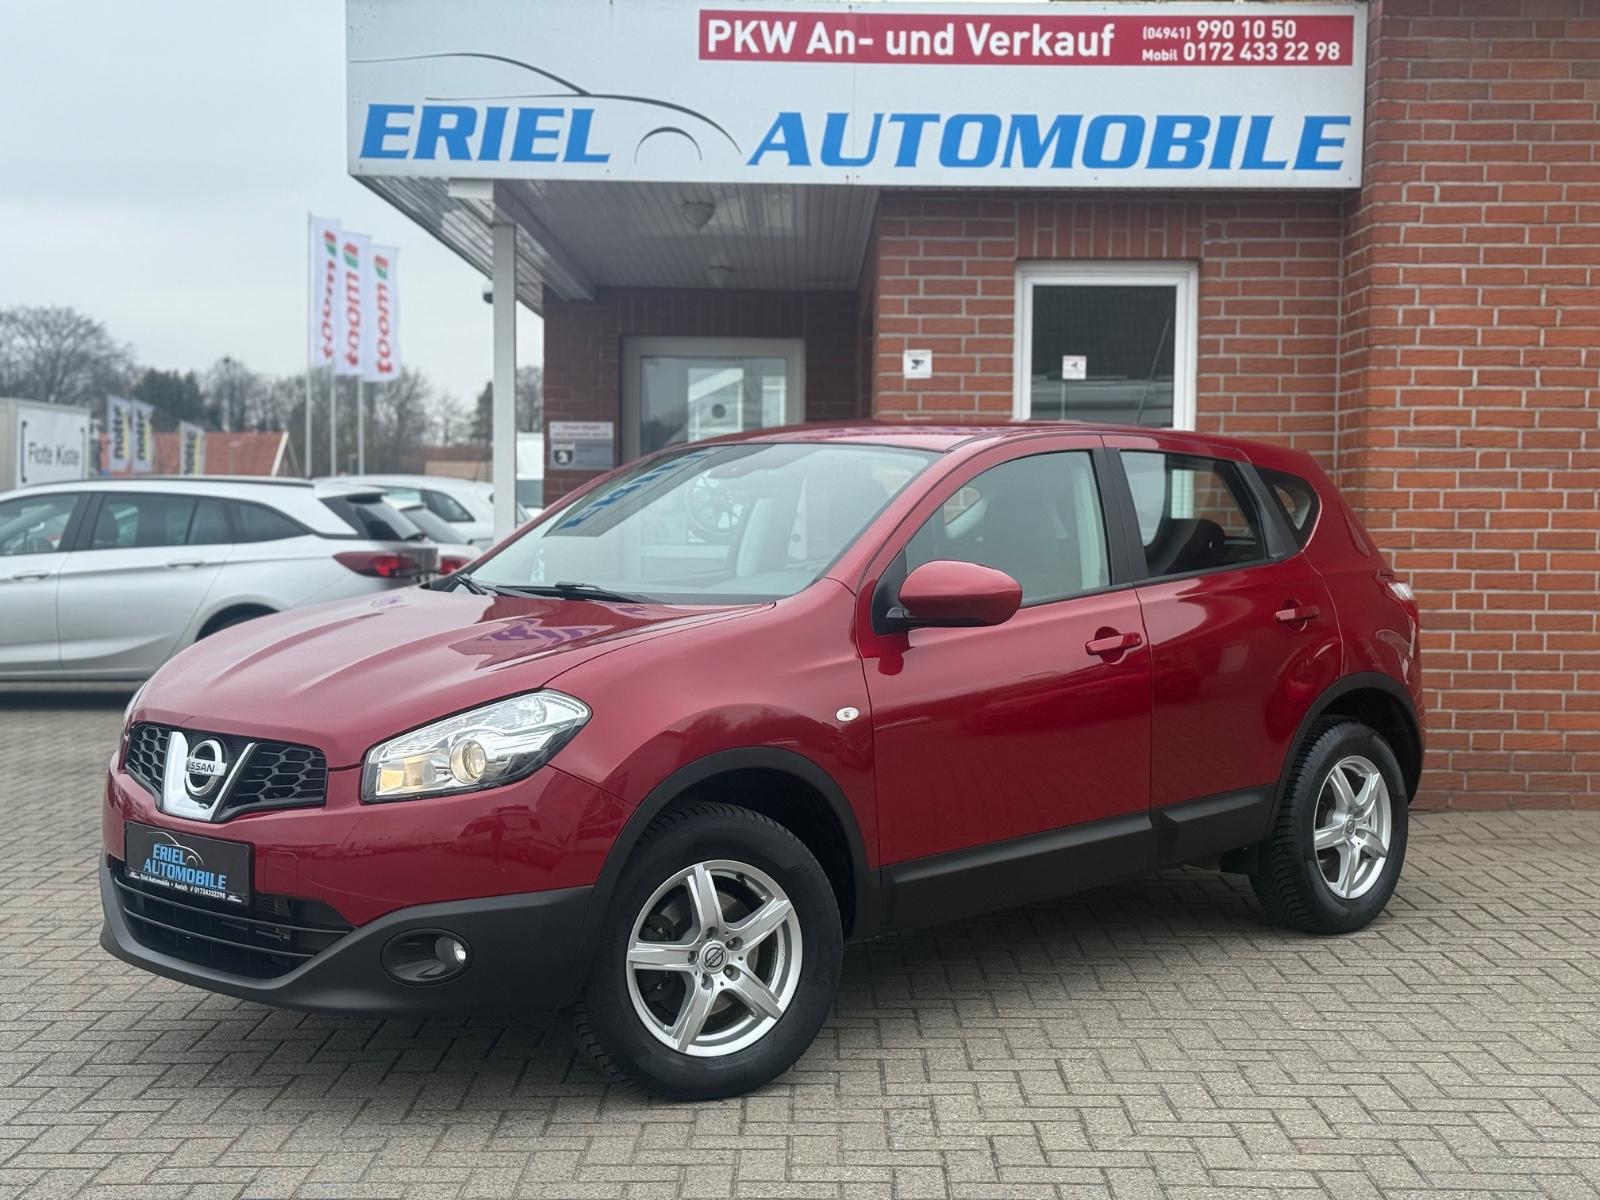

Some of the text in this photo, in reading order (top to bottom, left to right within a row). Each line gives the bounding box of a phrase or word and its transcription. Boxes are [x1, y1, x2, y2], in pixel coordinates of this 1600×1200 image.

[707, 20, 1115, 57] PKW An- und Verkauf
[1142, 20, 1297, 41] (04941) 990 10 50
[1142, 42, 1341, 62] Mobil 0172 433 22 98
[359, 103, 1352, 171] ERIEL AUTOMOBILE
[376, 282, 393, 374] toom
[187, 759, 216, 773] SSAN
[152, 843, 187, 866] ERIEL
[143, 858, 228, 890] AUTOMOBILE
